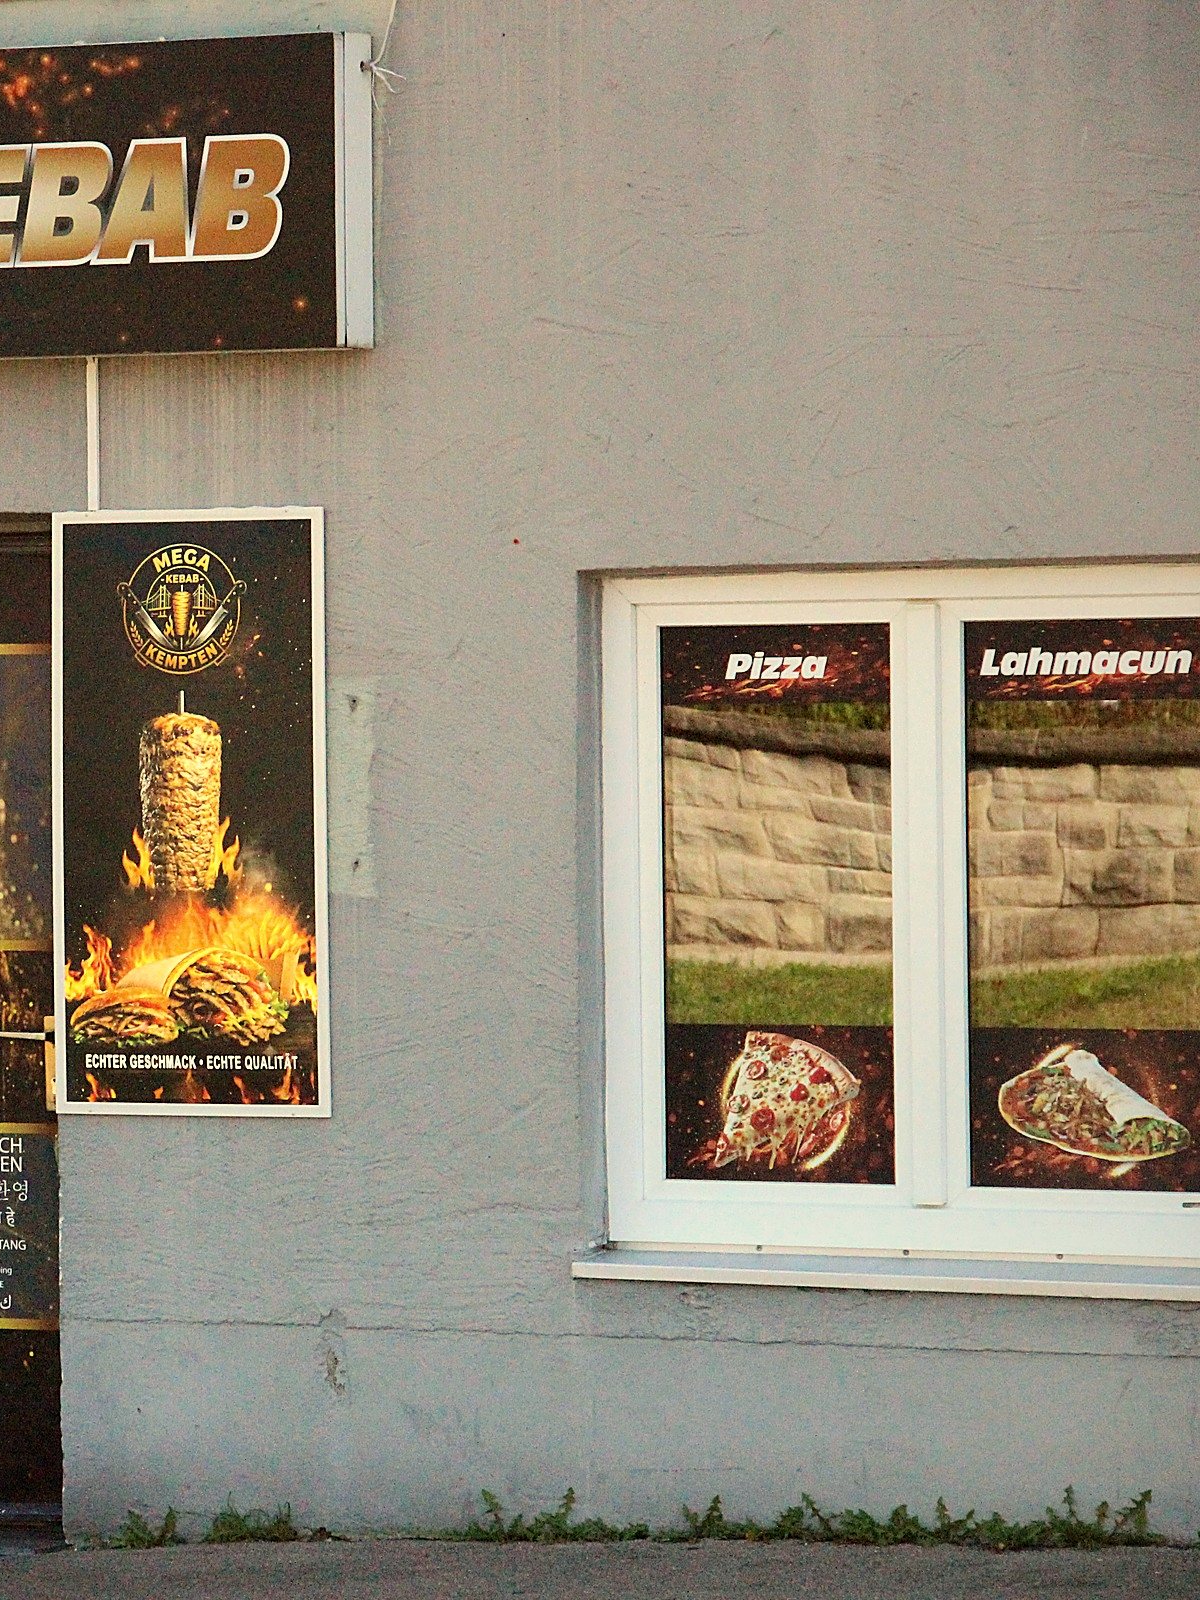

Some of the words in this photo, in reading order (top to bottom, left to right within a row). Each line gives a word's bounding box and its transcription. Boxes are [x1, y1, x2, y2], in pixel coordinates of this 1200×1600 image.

[152, 549, 211, 573] MEGA
[146, 643, 218, 670] KEMPTEN
[725, 651, 828, 680] Pizza
[979, 646, 1193, 677] Lahmacun
[85, 1053, 127, 1069] ECHTER
[129, 1053, 196, 1070] GESCHMACK
[206, 1055, 242, 1070] ECHTE
[244, 1052, 298, 1071] QUALITÄT
